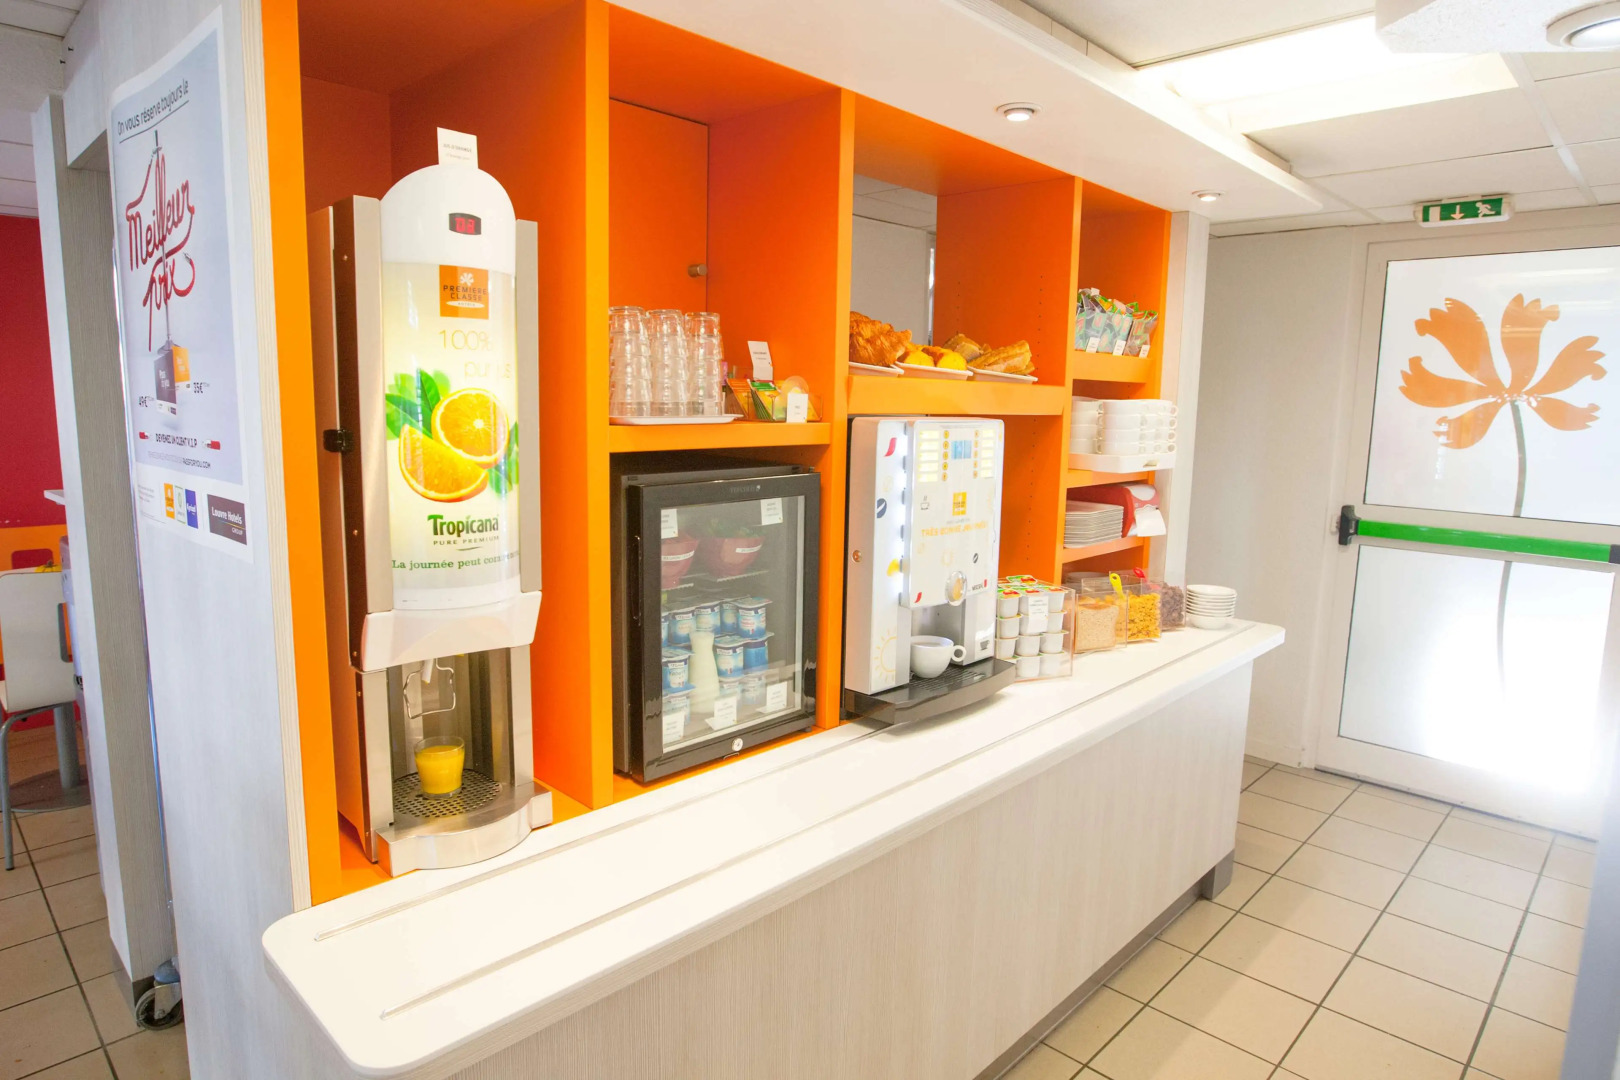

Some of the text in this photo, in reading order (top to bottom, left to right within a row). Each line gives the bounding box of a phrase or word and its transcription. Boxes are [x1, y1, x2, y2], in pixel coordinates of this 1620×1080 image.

[117, 78, 189, 136] On vous réserve toujours le
[125, 152, 195, 271] Meilleur
[443, 284, 487, 296] PREMIERE
[450, 293, 482, 301] CLASSE
[438, 329, 492, 351] 100%
[211, 506, 243, 524] Louvre Hotels
[427, 514, 499, 538] Tropicana
[462, 535, 500, 544] PREMIUM
[392, 560, 406, 569] La
[408, 558, 454, 571] journée
[458, 557, 481, 569] peut
